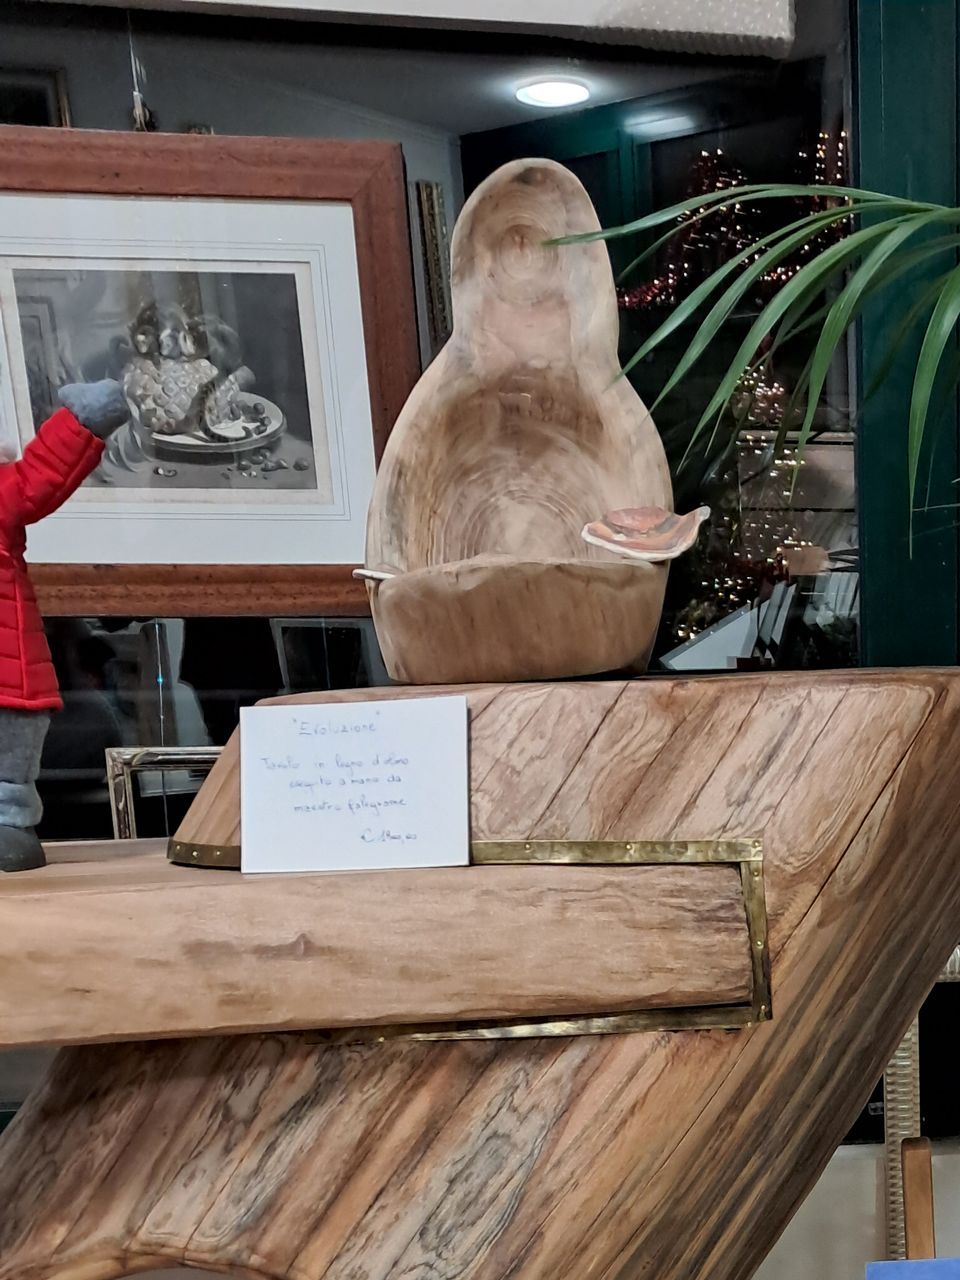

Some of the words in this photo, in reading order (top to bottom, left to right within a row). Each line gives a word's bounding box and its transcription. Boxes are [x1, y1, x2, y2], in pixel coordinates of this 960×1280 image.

[335, 753, 363, 774] legno
[338, 778, 346, 786] a
[350, 777, 379, 785] mano
[386, 773, 402, 783] da
